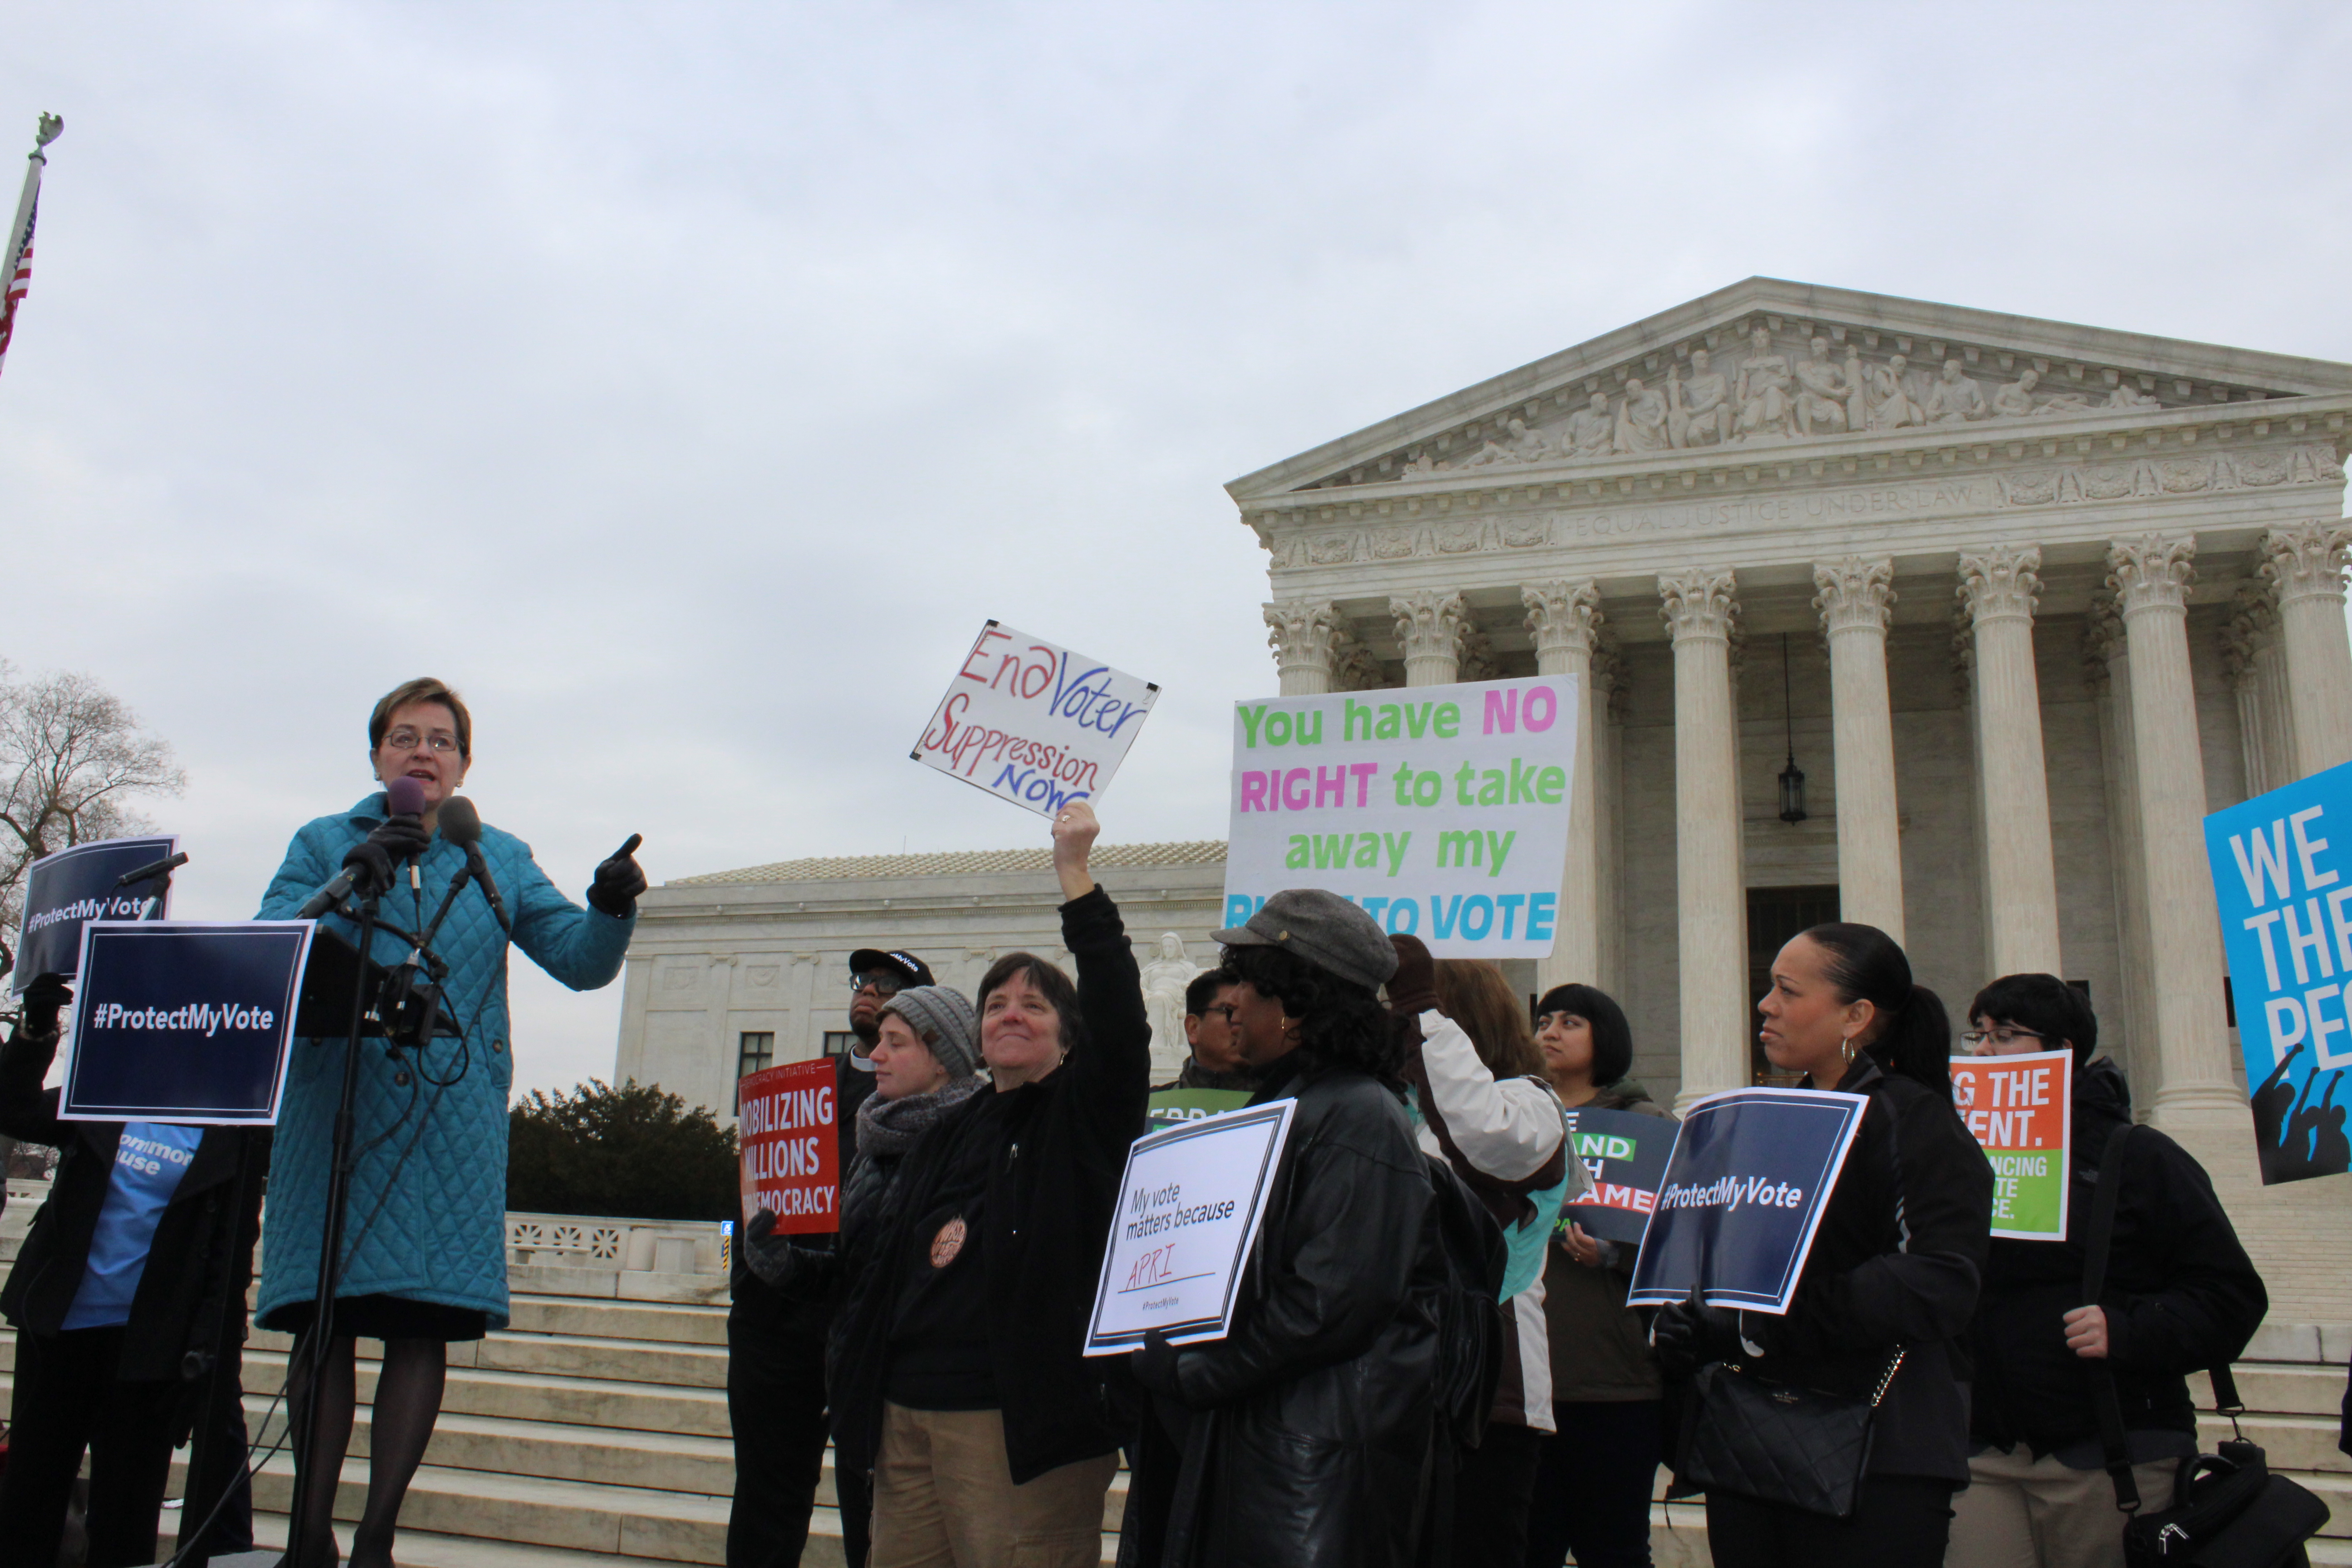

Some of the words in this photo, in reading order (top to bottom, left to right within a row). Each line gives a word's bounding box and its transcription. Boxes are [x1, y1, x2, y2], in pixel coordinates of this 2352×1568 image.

[1576, 514, 1671, 536] EQUAL
[1679, 501, 1790, 528] JUSTICE
[1805, 491, 1905, 516] UNDER
[1916, 485, 1973, 508] LAW
[959, 630, 1057, 699] End
[1049, 652, 1147, 738] Voter
[1237, 704, 1323, 748] You
[1343, 698, 1460, 742] have
[1483, 686, 1557, 735] NO
[926, 693, 1096, 791] Suppression
[1240, 762, 1378, 812] RIGHT
[1392, 761, 1442, 807] to
[1454, 758, 1566, 806] take
[1285, 831, 1411, 877] away
[1437, 829, 1516, 877] my
[2228, 804, 2340, 907] WE
[1362, 897, 1419, 935] TO
[1431, 892, 1556, 941] VOTE
[94, 1003, 273, 1037] #ProtectMyVote
[2264, 978, 2352, 1080] PE
[776, 1063, 816, 1079] INITIATIVE
[1989, 1068, 2050, 1107] THE
[740, 1086, 833, 1138] MOBILIZING
[1957, 1110, 2042, 1147] ENT.
[116, 1148, 161, 1175] use
[120, 1134, 194, 1166] ommon
[745, 1137, 819, 1182] MILLIONS
[1989, 1156, 2047, 1176] NCING
[1131, 1187, 1150, 1219] My
[1153, 1182, 1180, 1208] vote
[1573, 1182, 1654, 1213] AME
[1661, 1176, 1803, 1212] #ProtectMyVote
[1995, 1177, 2019, 1198] TE
[1126, 1213, 1172, 1241] matters
[1173, 1200, 1235, 1228] because
[1126, 1243, 1176, 1291] APRI
[1142, 1296, 1179, 1311] #ProtectMyVote
